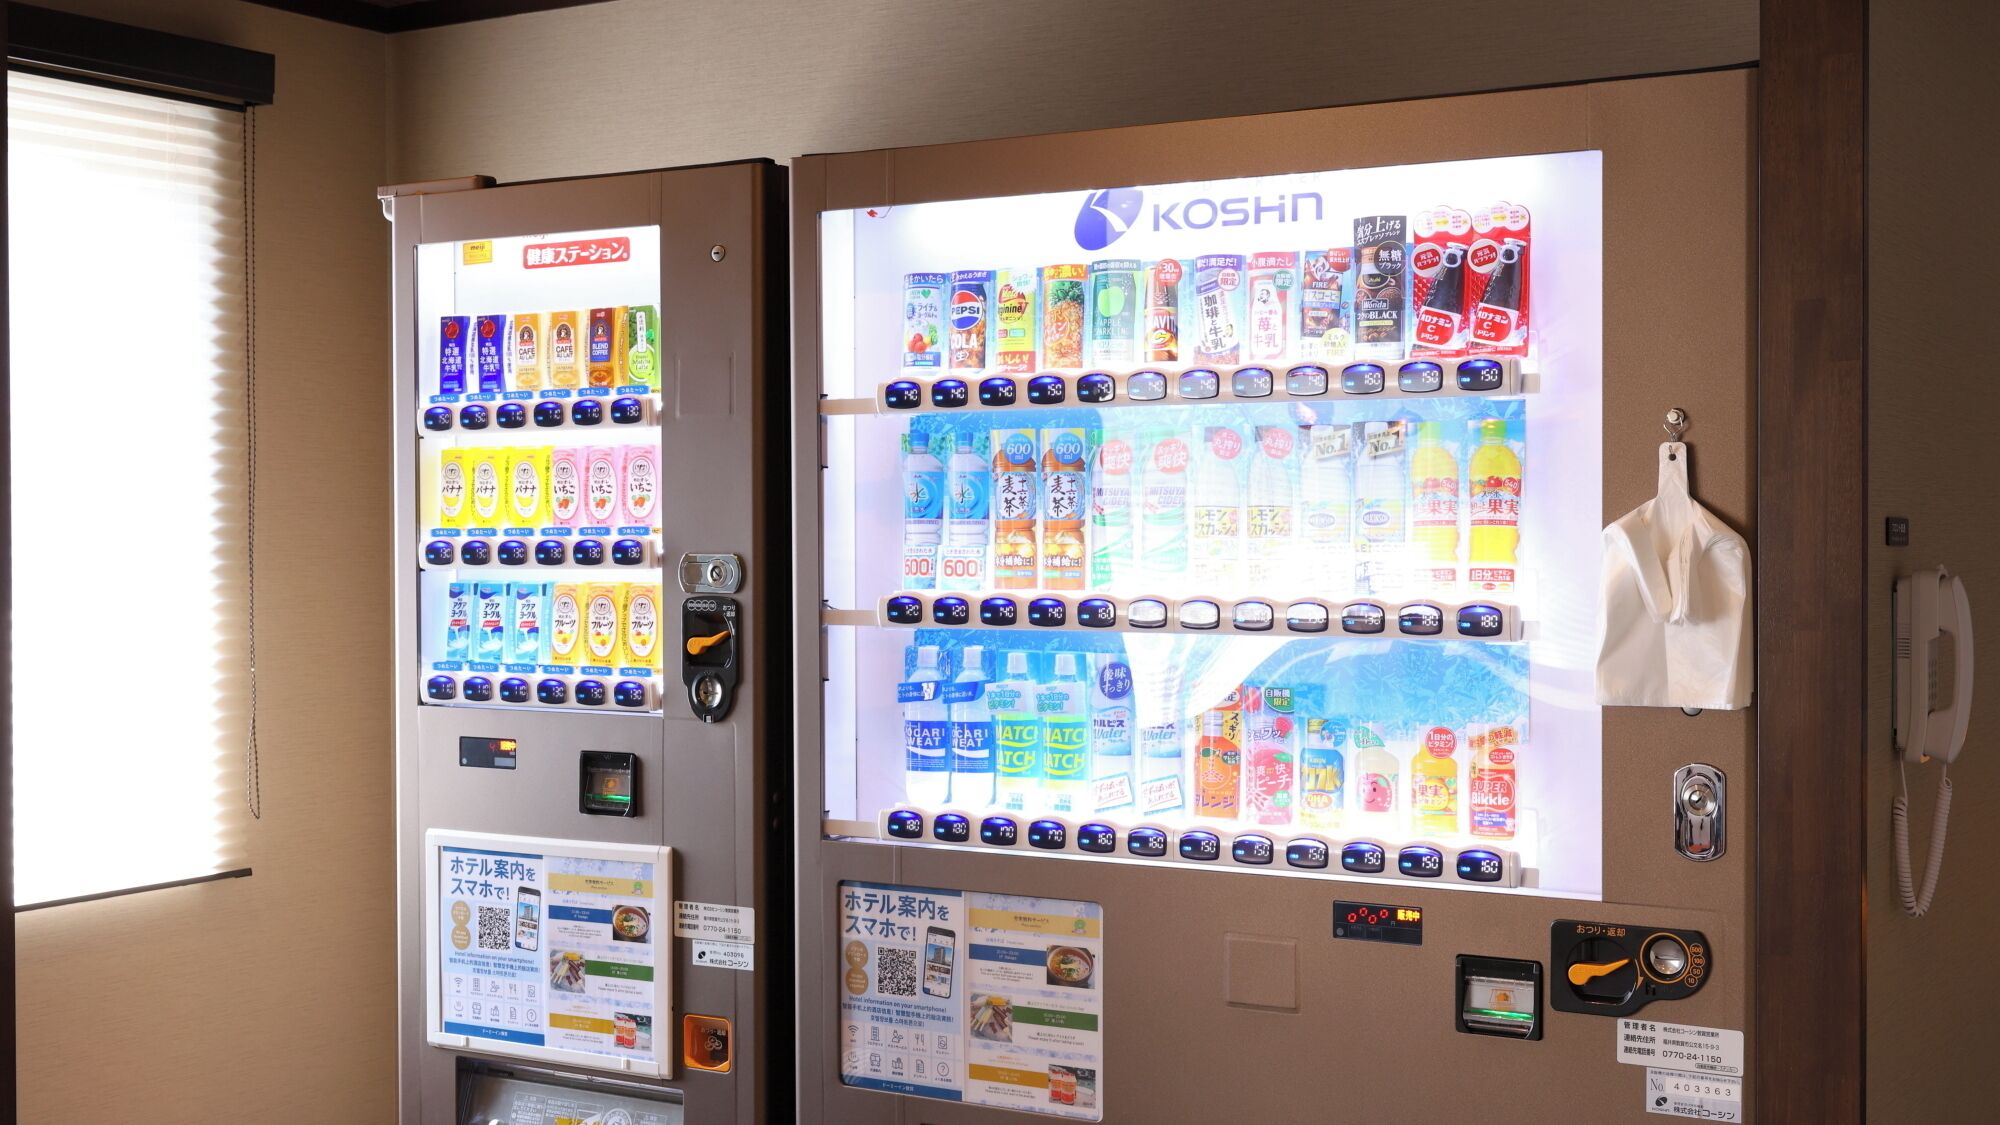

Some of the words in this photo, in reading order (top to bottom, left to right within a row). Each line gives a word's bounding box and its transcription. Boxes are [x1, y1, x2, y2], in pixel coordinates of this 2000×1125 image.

[1378, 249, 1402, 262] 無糖
[1219, 277, 1237, 286] 限定
[951, 305, 981, 315] PEPSI
[1204, 294, 1226, 351] 珈琲と牛乳
[1420, 314, 1452, 327] オロナミン
[1477, 311, 1509, 324] オロナミン
[1426, 325, 1436, 333] C
[1254, 333, 1279, 348] 牛乳
[1364, 373, 1381, 385] 160
[1422, 371, 1439, 383] 150
[1480, 369, 1498, 382] 150
[1096, 383, 1112, 393] 140
[1253, 377, 1270, 389] 140
[904, 390, 918, 401] 140
[951, 388, 965, 399] 140
[628, 405, 640, 416] 130
[1006, 443, 1031, 454] 600
[1056, 442, 1080, 454] 600
[1315, 433, 1349, 455] No.1
[1368, 430, 1404, 455] No.1
[442, 485, 462, 494] バナナ
[476, 485, 496, 494] バナナ
[515, 485, 537, 494] バナナ
[554, 485, 575, 495] いちご
[591, 484, 613, 495] いちご
[630, 482, 652, 493] いちご
[1017, 477, 1029, 509] 十六茶
[1066, 477, 1078, 509] 十六茶
[1096, 487, 1130, 497] MITSUYA
[1149, 487, 1185, 496] MITSUYA
[1002, 475, 1020, 517] 麦茶
[1050, 475, 1068, 517] 麦茶
[1102, 498, 1130, 506] CIDER
[1157, 496, 1185, 505] CIDER
[1427, 499, 1458, 515] 果実
[1488, 499, 1519, 515] 果実
[1196, 509, 1228, 521] レモン
[1250, 509, 1279, 521] レモン
[943, 559, 978, 577] 600
[905, 605, 919, 616] 120
[952, 606, 966, 617] 120
[1047, 607, 1062, 618] 140
[554, 619, 576, 628] フルーツ
[591, 620, 614, 630] フルーツ
[632, 620, 654, 630] フルーツ
[1421, 614, 1439, 626] 180
[1480, 614, 1498, 628] 180
[1103, 680, 1130, 693] すっきり
[1265, 689, 1291, 698] 自販機
[1273, 698, 1290, 706] 限定
[1230, 711, 1240, 740] スッキリ
[1093, 729, 1126, 740] Water
[1143, 729, 1176, 741] Water
[1428, 732, 1453, 741] 1日分の
[1427, 740, 1455, 748] ビタミン!
[1256, 774, 1291, 791] ピーチ
[1472, 781, 1507, 793] SUPER
[1418, 785, 1441, 797] 果実
[1471, 793, 1509, 805] Bikkle
[952, 822, 966, 834] 180
[1148, 836, 1164, 849] 160
[1253, 844, 1270, 857] 150
[1308, 848, 1325, 861] 150
[450, 856, 536, 881] ホテル案内を
[1421, 856, 1439, 869] 150
[1480, 860, 1498, 874] 160
[845, 891, 950, 921] ホテル案内を
[1397, 909, 1421, 922] 販売中
[1576, 924, 1626, 937] おつり・返却
[709, 958, 749, 968] 株式会社コーシン
[1662, 1050, 1722, 1063] 0770-24-1150
[1673, 1106, 1735, 1120] 株式会社コーシン
